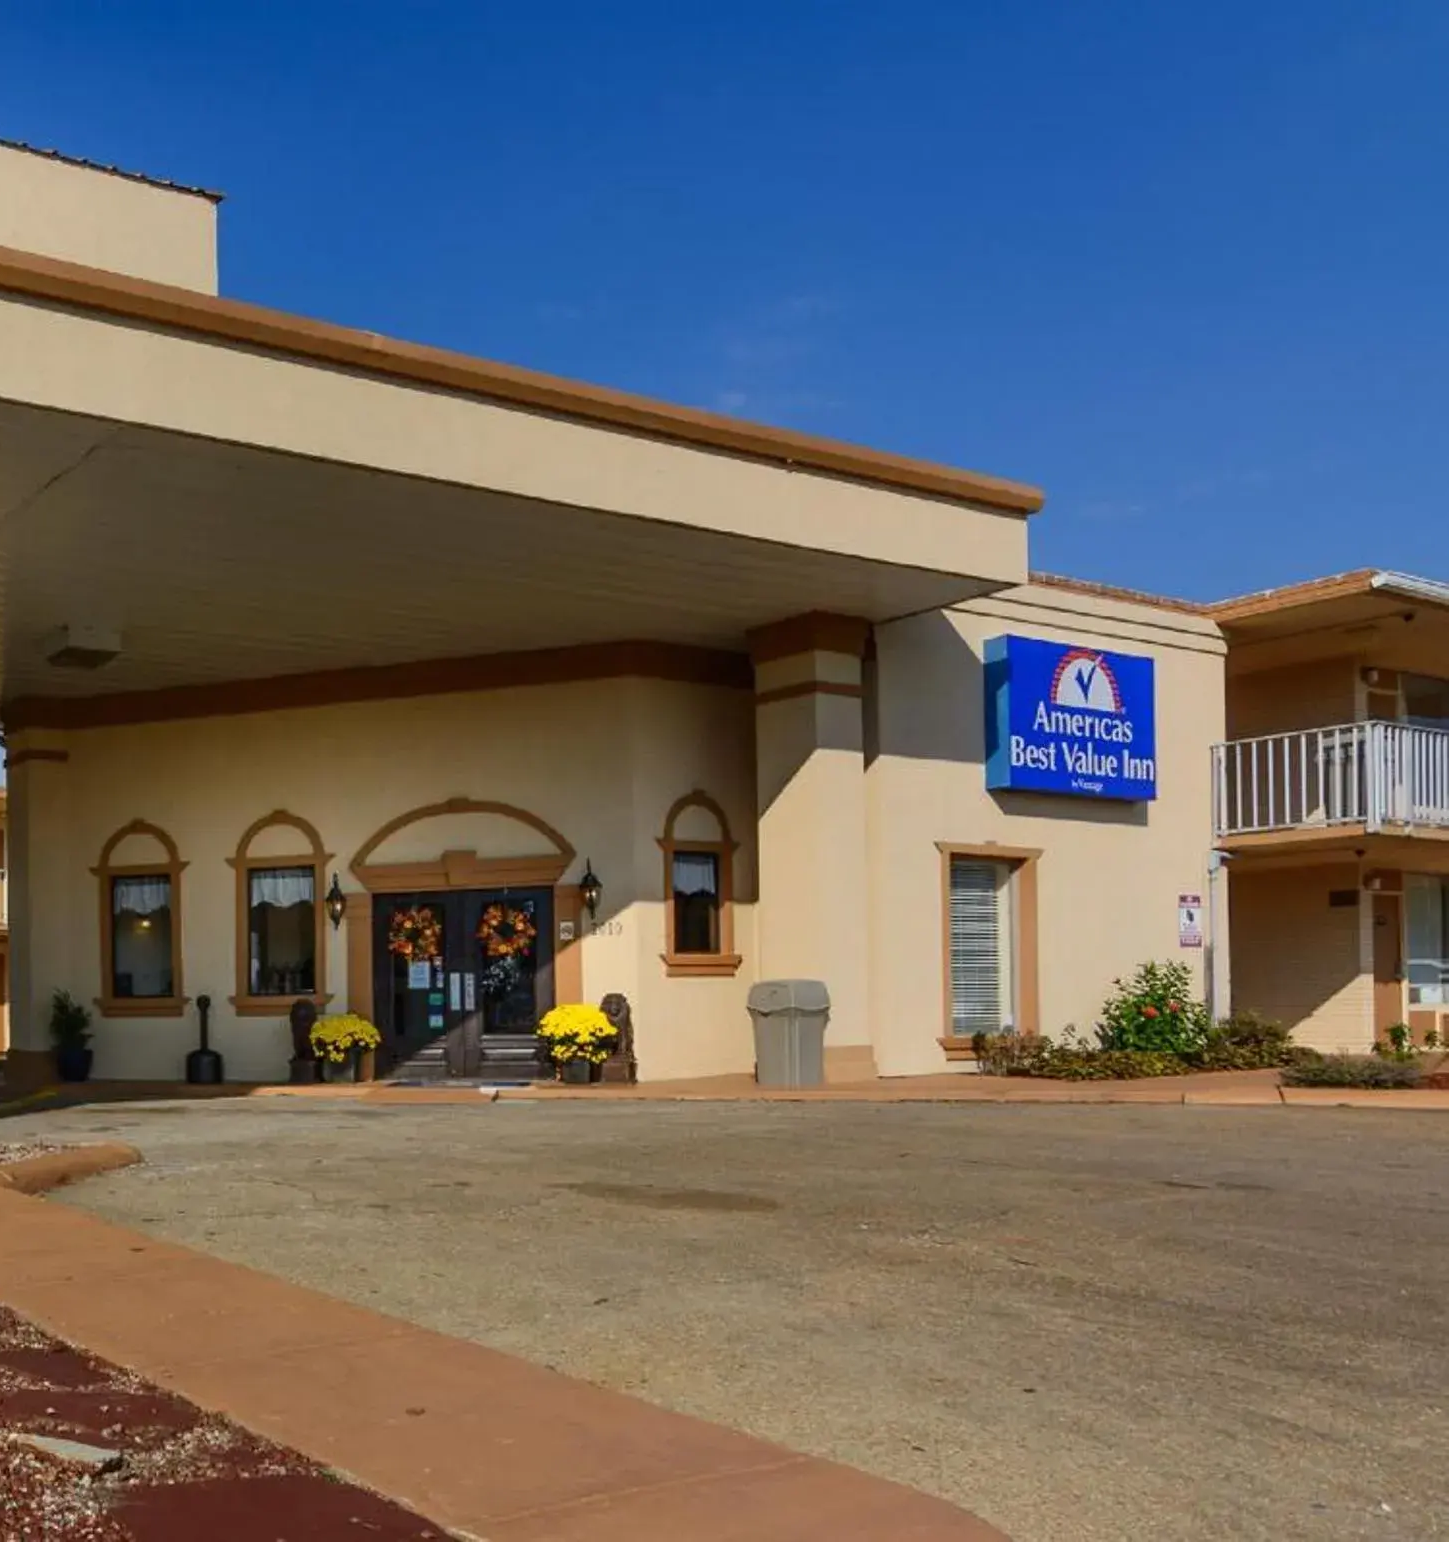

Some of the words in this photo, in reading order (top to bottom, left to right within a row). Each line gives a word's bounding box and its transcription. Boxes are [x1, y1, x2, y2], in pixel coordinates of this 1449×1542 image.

[1033, 700, 1133, 743] Americas
[1010, 735, 1057, 772] Best
[1062, 742, 1118, 778] Value
[1123, 750, 1155, 781] Inn
